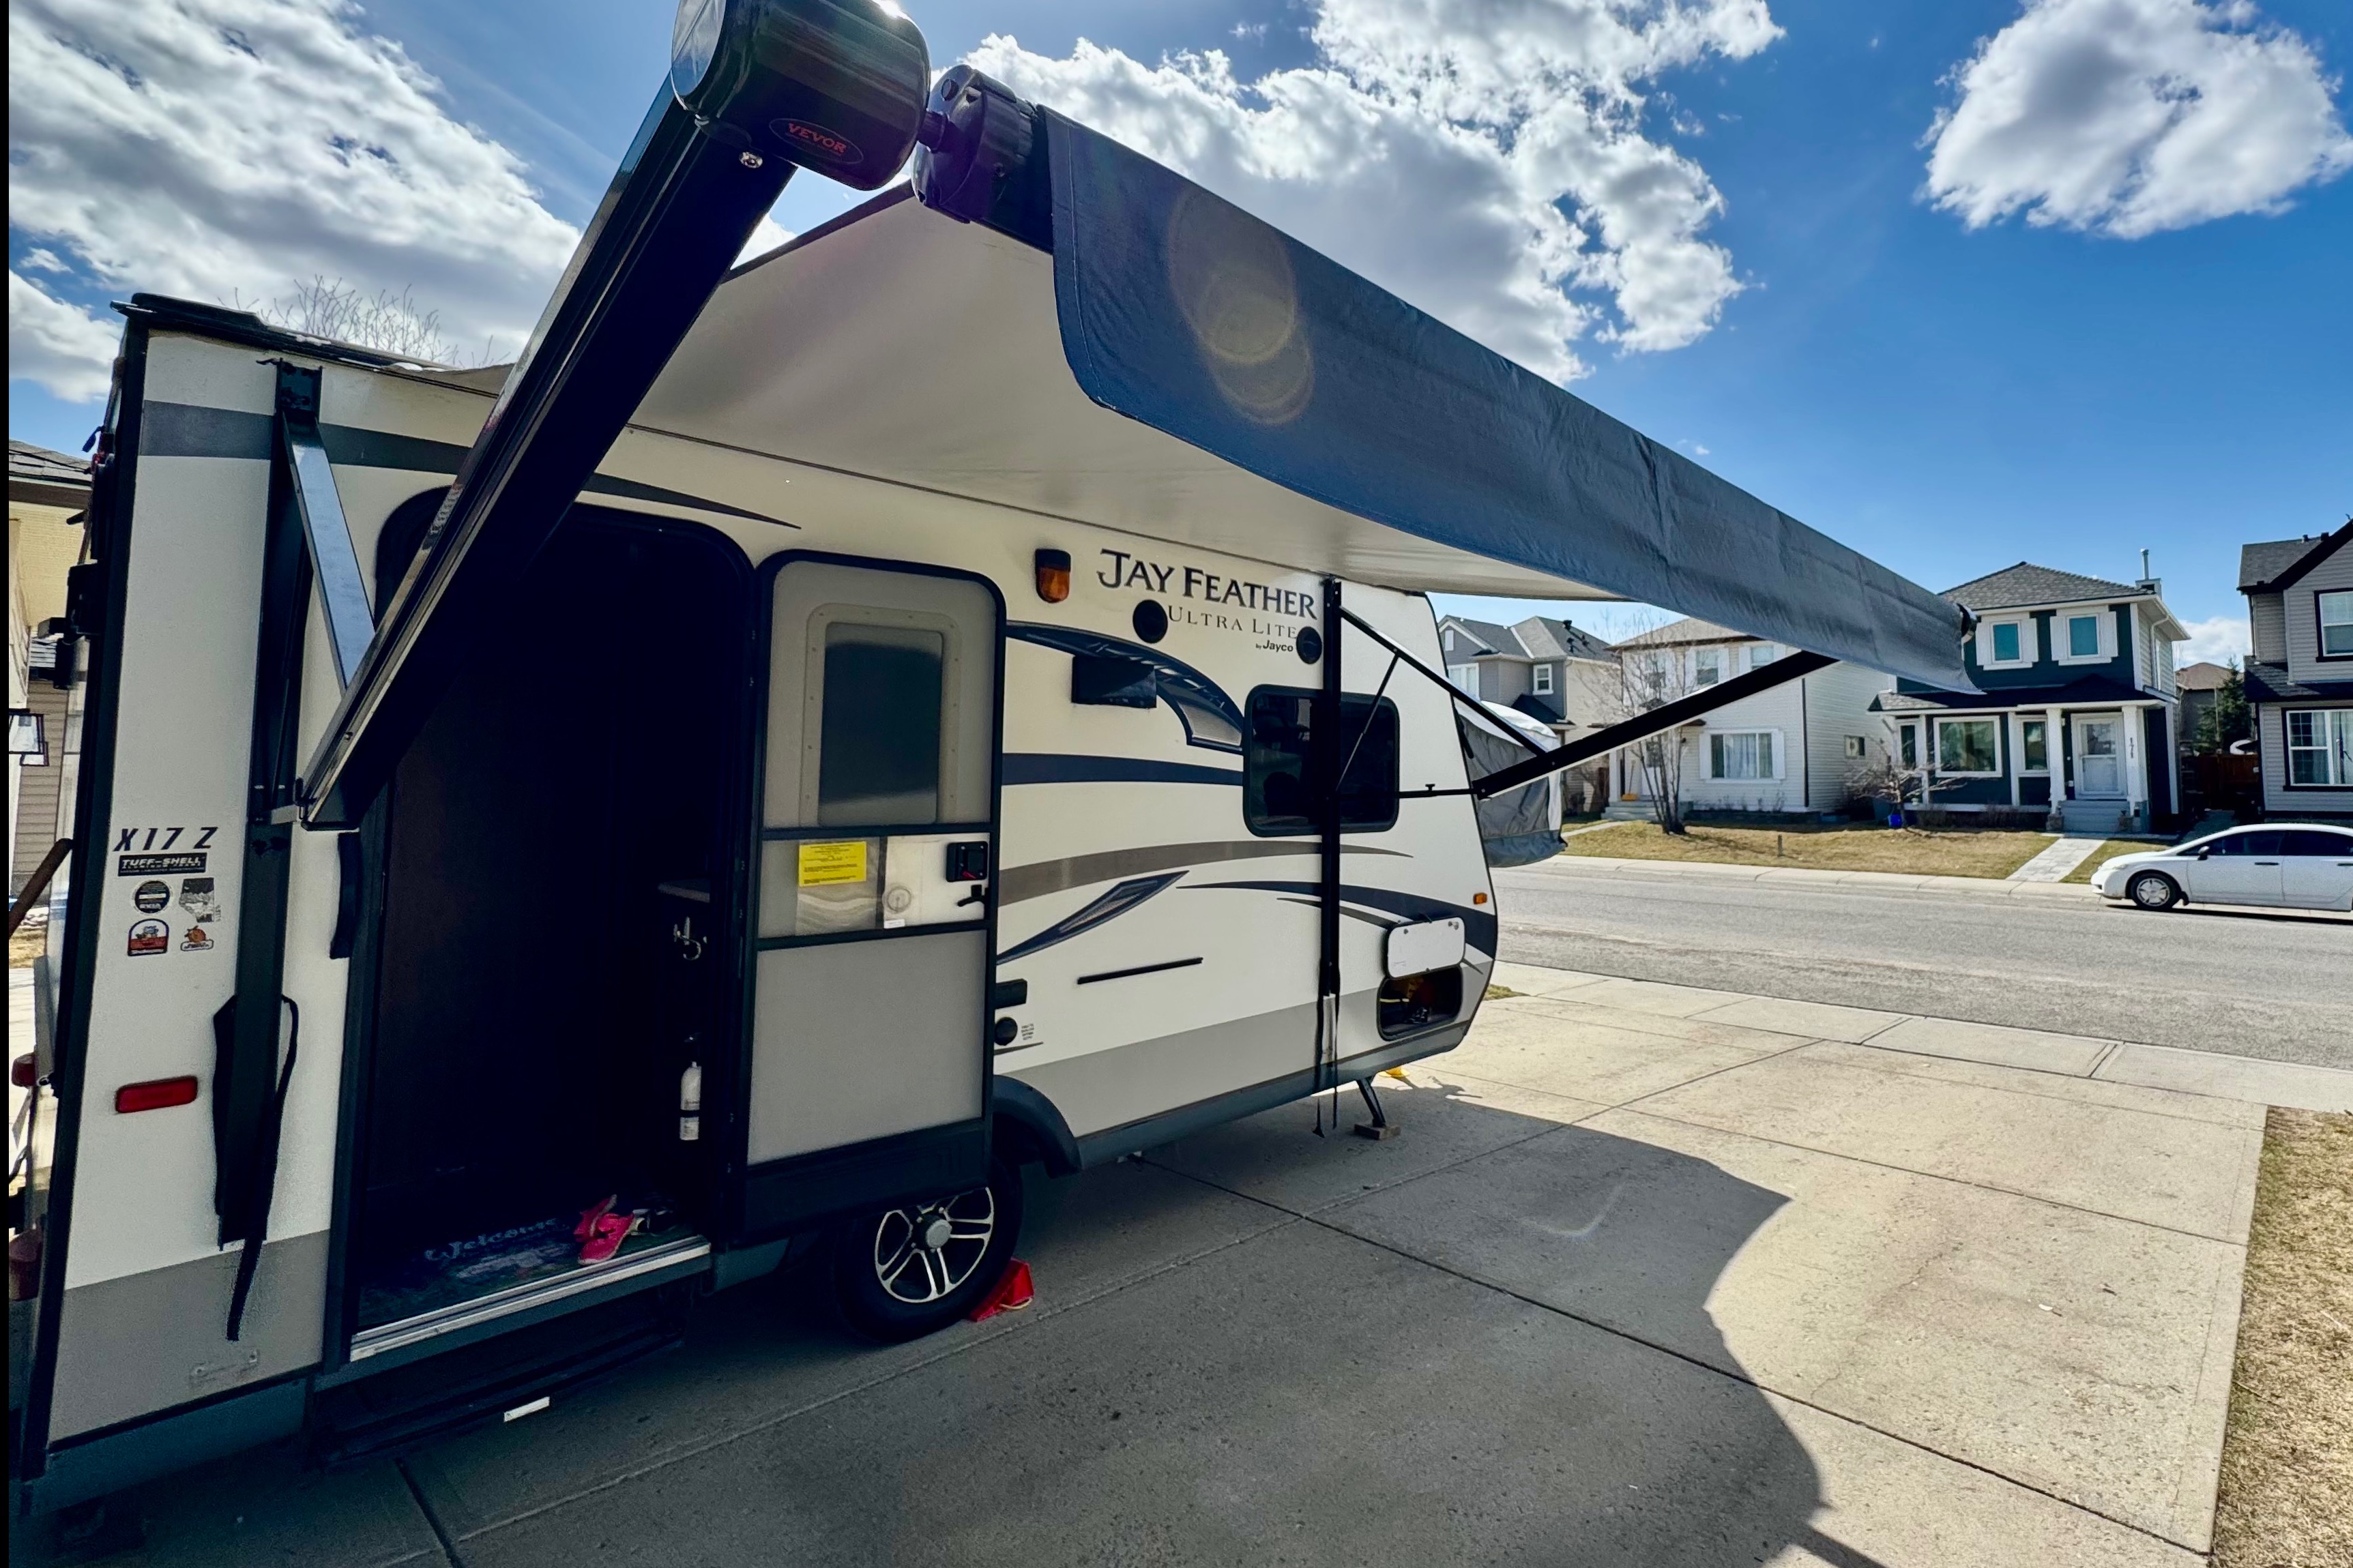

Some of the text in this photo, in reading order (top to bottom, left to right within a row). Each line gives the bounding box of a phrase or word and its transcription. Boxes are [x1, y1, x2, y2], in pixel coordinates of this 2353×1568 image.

[788, 123, 847, 153] VEVOR
[1096, 548, 1318, 620] JAY FEATHER
[1168, 605, 1297, 640] ULTRA LITE
[1262, 639, 1294, 653] Jayco
[113, 827, 218, 852] X17 Z
[121, 857, 201, 867] TUFF-SHELL
